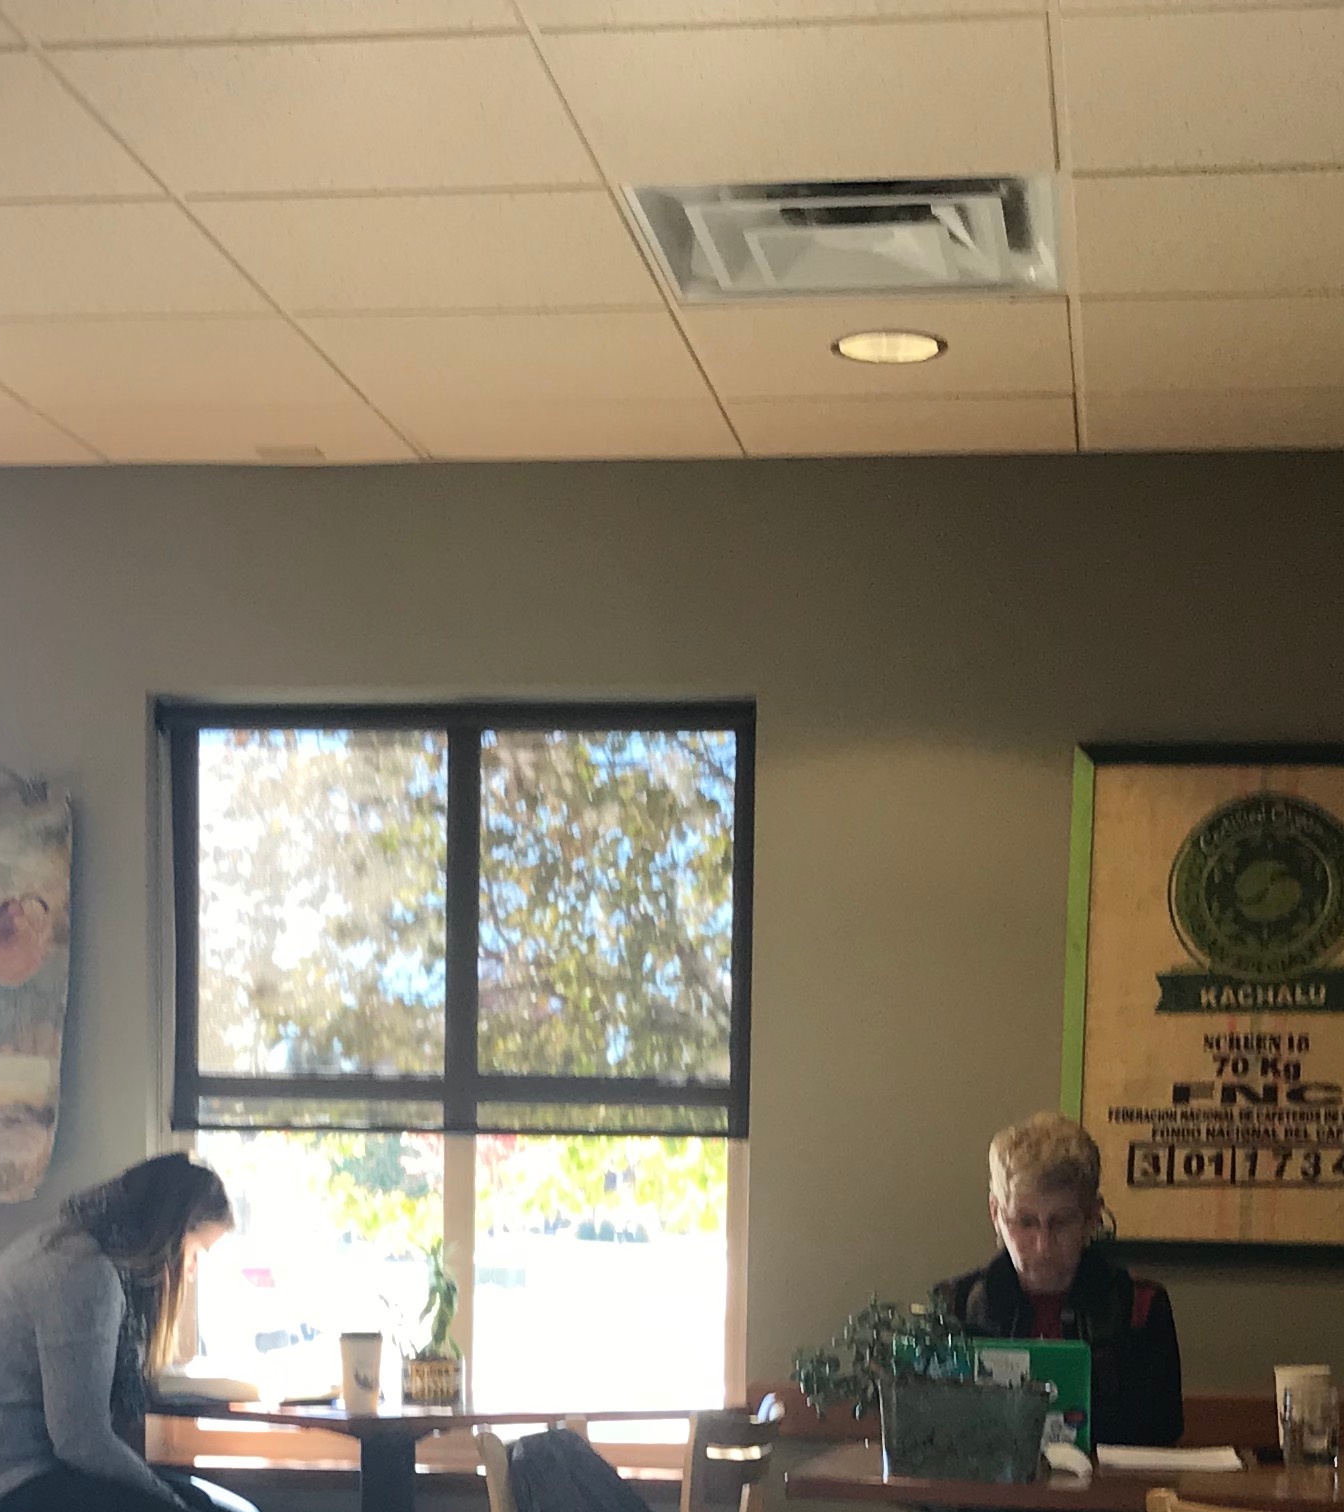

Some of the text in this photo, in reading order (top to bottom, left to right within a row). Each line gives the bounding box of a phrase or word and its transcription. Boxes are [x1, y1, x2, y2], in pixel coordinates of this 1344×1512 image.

[1213, 1054, 1302, 1082] 70 Kg
[1172, 1082, 1343, 1105] FNC
[1179, 1106, 1235, 1123] NACIONAL
[1238, 1107, 1255, 1123] DE
[1151, 1124, 1202, 1141] FONDO
[1205, 1124, 1279, 1141] NACIONAL
[1283, 1125, 1310, 1141] DEL
